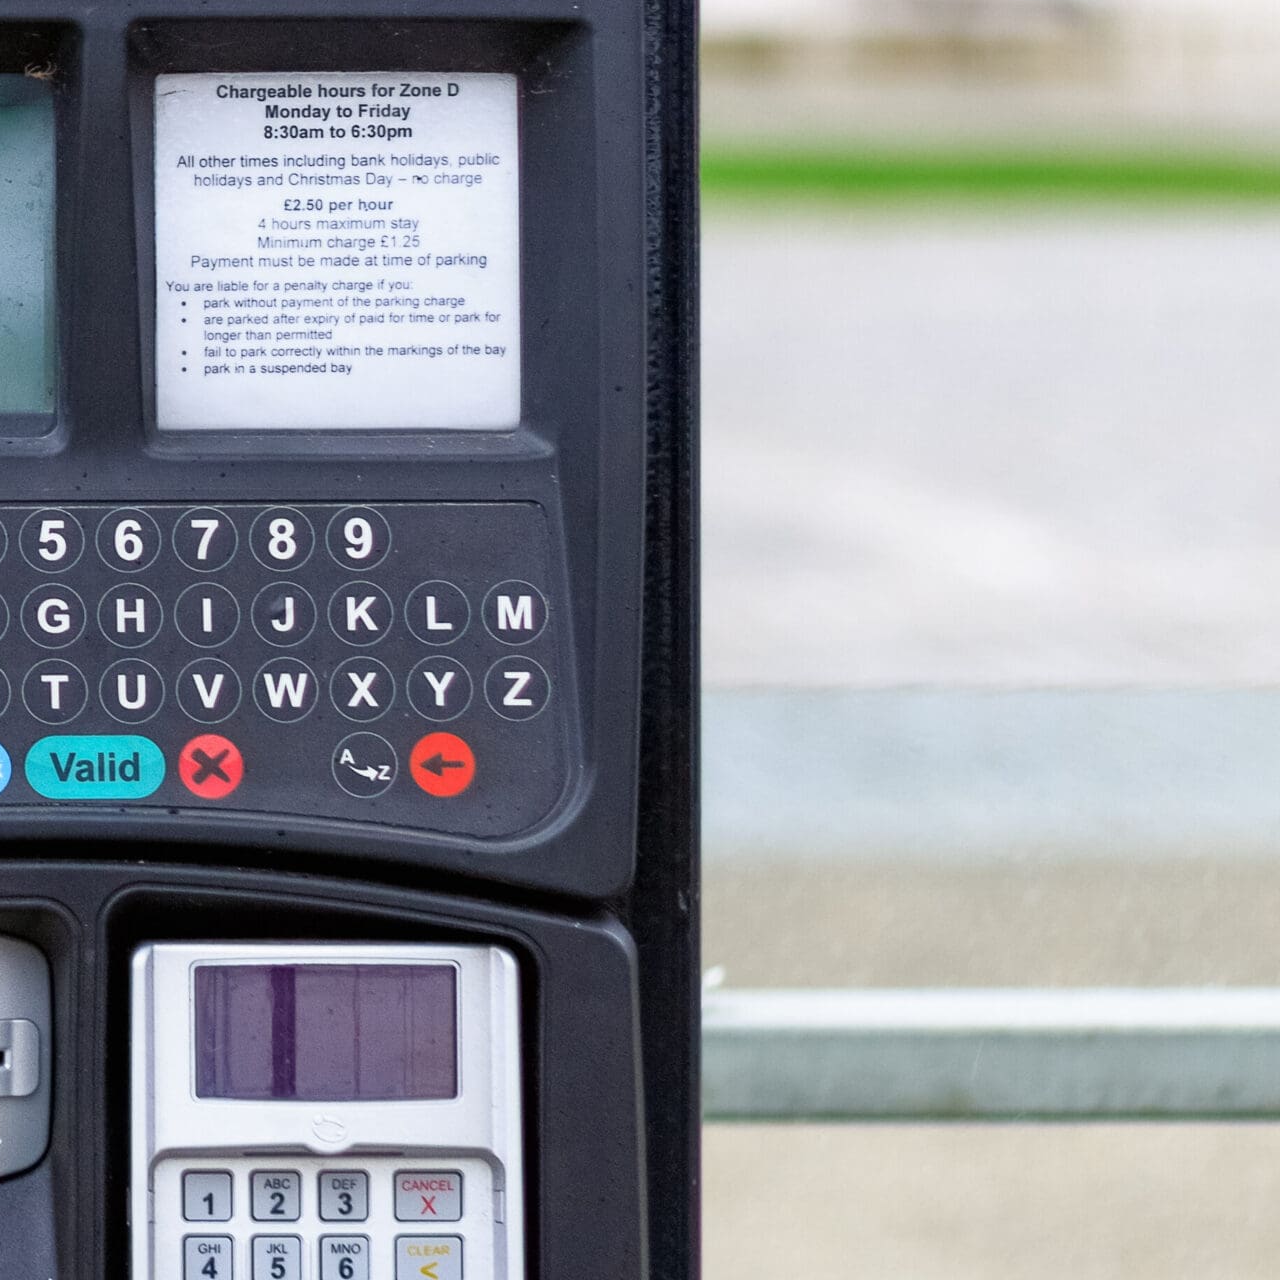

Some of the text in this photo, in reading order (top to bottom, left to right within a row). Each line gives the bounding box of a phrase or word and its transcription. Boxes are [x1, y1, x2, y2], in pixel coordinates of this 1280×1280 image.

[216, 83, 459, 101] Chargeable hours for Zone D
[266, 104, 411, 121] Monday to Friday
[264, 124, 412, 141] 8:30am to 6:30pm
[177, 153, 500, 170] All other times including bank holidays, public
[284, 199, 393, 213] £2.50 per hour
[39, 520, 66, 561] 5
[115, 520, 143, 561] 6
[191, 520, 219, 559] 7
[269, 519, 296, 559] 8
[344, 518, 372, 559] 9
[38, 599, 70, 633] G
[117, 599, 145, 632] H
[203, 598, 212, 632] I
[272, 597, 294, 631] J
[347, 597, 378, 630] K
[427, 596, 452, 630] L
[497, 596, 532, 630] M
[41, 675, 69, 709] T
[118, 675, 146, 709] U
[193, 674, 224, 708] V
[264, 673, 307, 708] W
[348, 672, 378, 707] X
[423, 672, 454, 706] Y
[503, 672, 532, 706] Z
[50, 752, 140, 782] Valid
[340, 749, 355, 767] A
[378, 765, 390, 780] Z
[264, 1178, 290, 1192] ABC
[332, 1178, 357, 1192] DEF
[402, 1178, 454, 1193] CANCEL
[203, 1193, 213, 1215] 1
[270, 1192, 285, 1214] 2
[338, 1192, 353, 1215] 3
[198, 1243, 220, 1254] GHI
[266, 1244, 288, 1254] JKL
[331, 1243, 361, 1254] MNO
[407, 1245, 450, 1256] CLEAR
[202, 1257, 217, 1279] 4
[271, 1257, 285, 1279] 5
[339, 1257, 353, 1279] 6
